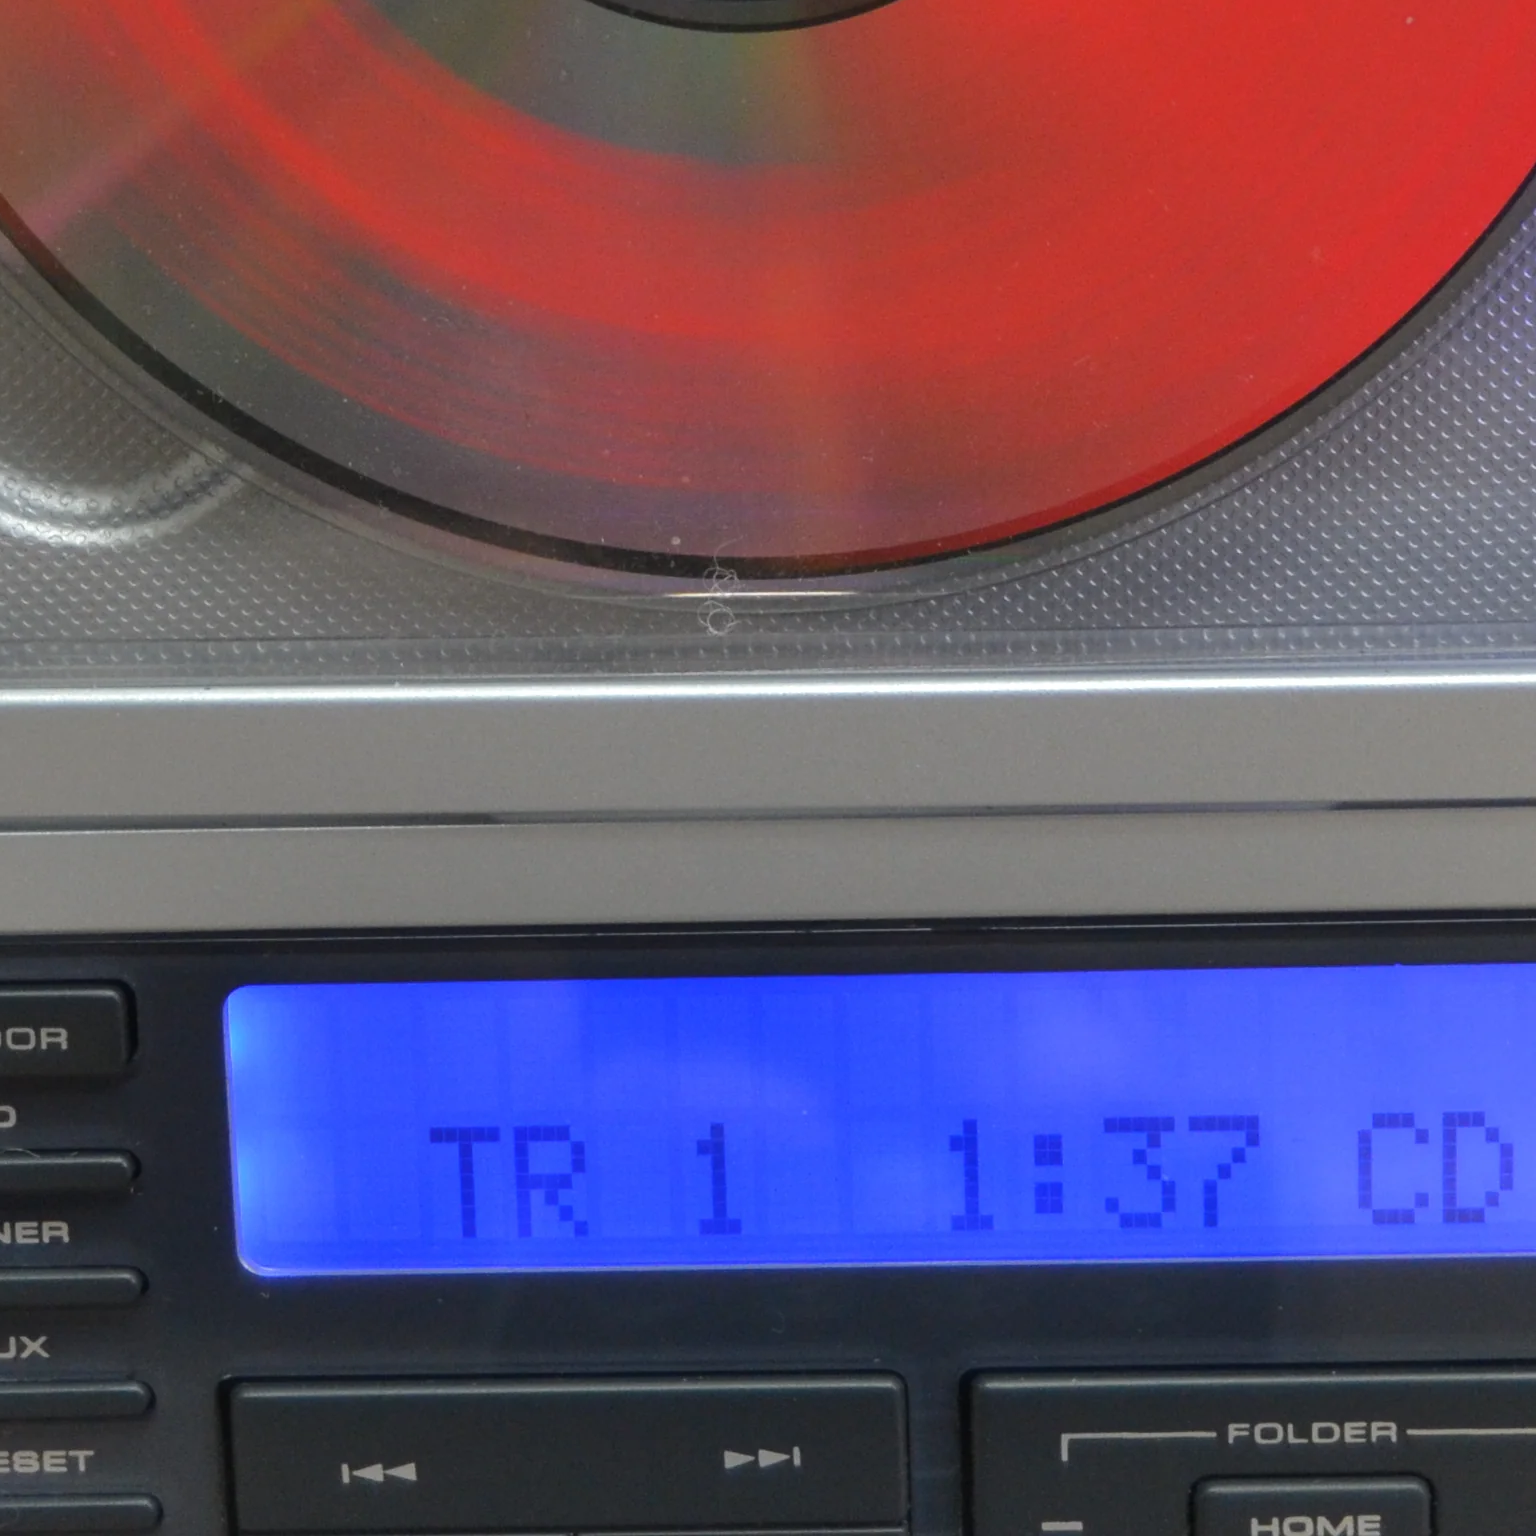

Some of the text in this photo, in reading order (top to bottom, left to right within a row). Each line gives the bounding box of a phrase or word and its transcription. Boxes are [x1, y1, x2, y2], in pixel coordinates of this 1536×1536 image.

[429, 1112, 1514, 1238] TR 1 1:37 CD
[1227, 1421, 1398, 1445] FOLDER
[1250, 1514, 1382, 1536] HOME
